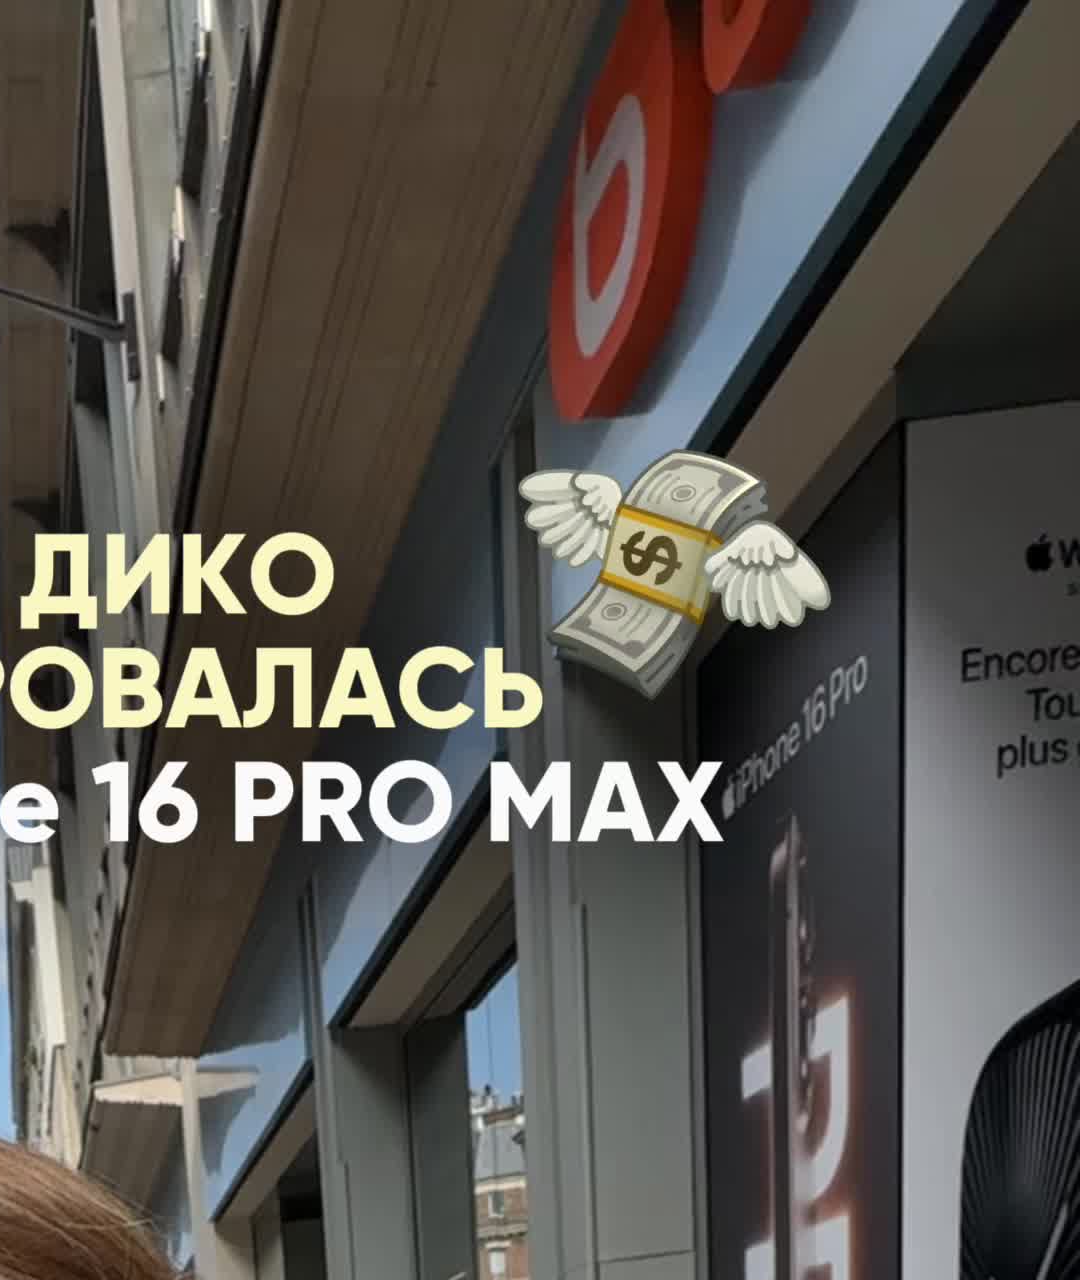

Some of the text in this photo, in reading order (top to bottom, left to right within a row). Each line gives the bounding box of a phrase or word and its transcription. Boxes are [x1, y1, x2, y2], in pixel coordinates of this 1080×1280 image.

[961, 643, 1080, 683] Encore
[735, 655, 868, 809] iPhone 16 Pro
[997, 733, 1069, 780] plus
